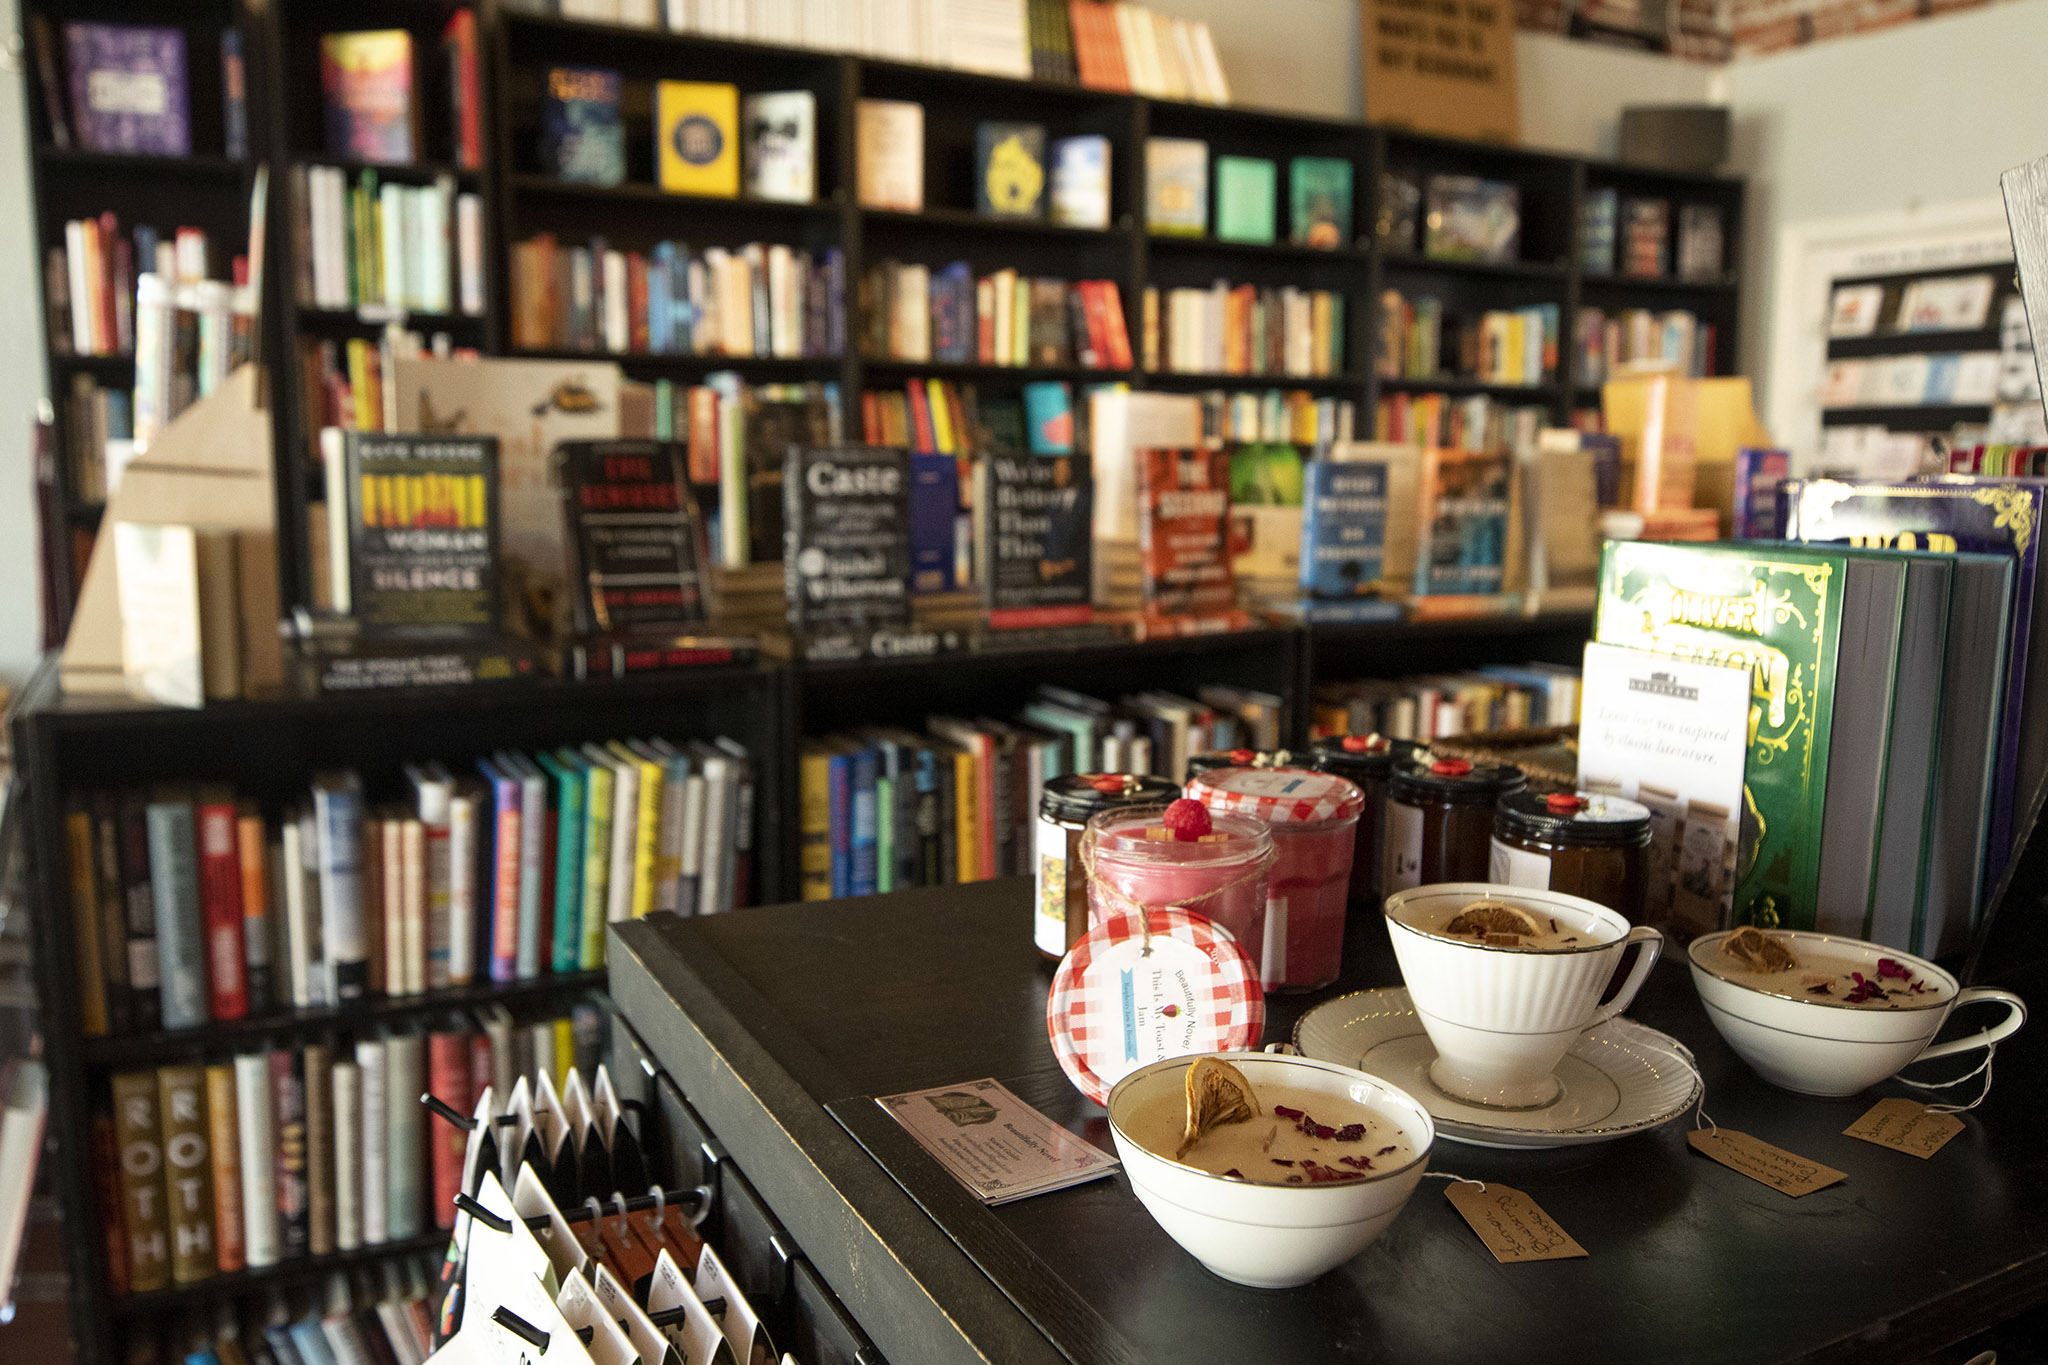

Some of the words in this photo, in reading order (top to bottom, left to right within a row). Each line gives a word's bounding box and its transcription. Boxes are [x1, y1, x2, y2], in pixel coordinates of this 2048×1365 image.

[807, 461, 900, 496] Caste
[372, 566, 482, 591] SILENCE
[1671, 590, 1763, 636] OLIVER
[871, 631, 939, 658] Caste
[1657, 718, 1675, 732] tea
[1679, 723, 1731, 743] inspired
[1152, 968, 1163, 991] This
[1175, 969, 1197, 1018] Beautifully
[1153, 993, 1164, 1003] Is
[1137, 1006, 1148, 1027] Jam
[1151, 1005, 1165, 1020] My
[1155, 1022, 1167, 1051] Toast
[1181, 1020, 1197, 1050] Novel
[121, 1095, 166, 1267] ROTH
[167, 1089, 210, 1258] ROTH
